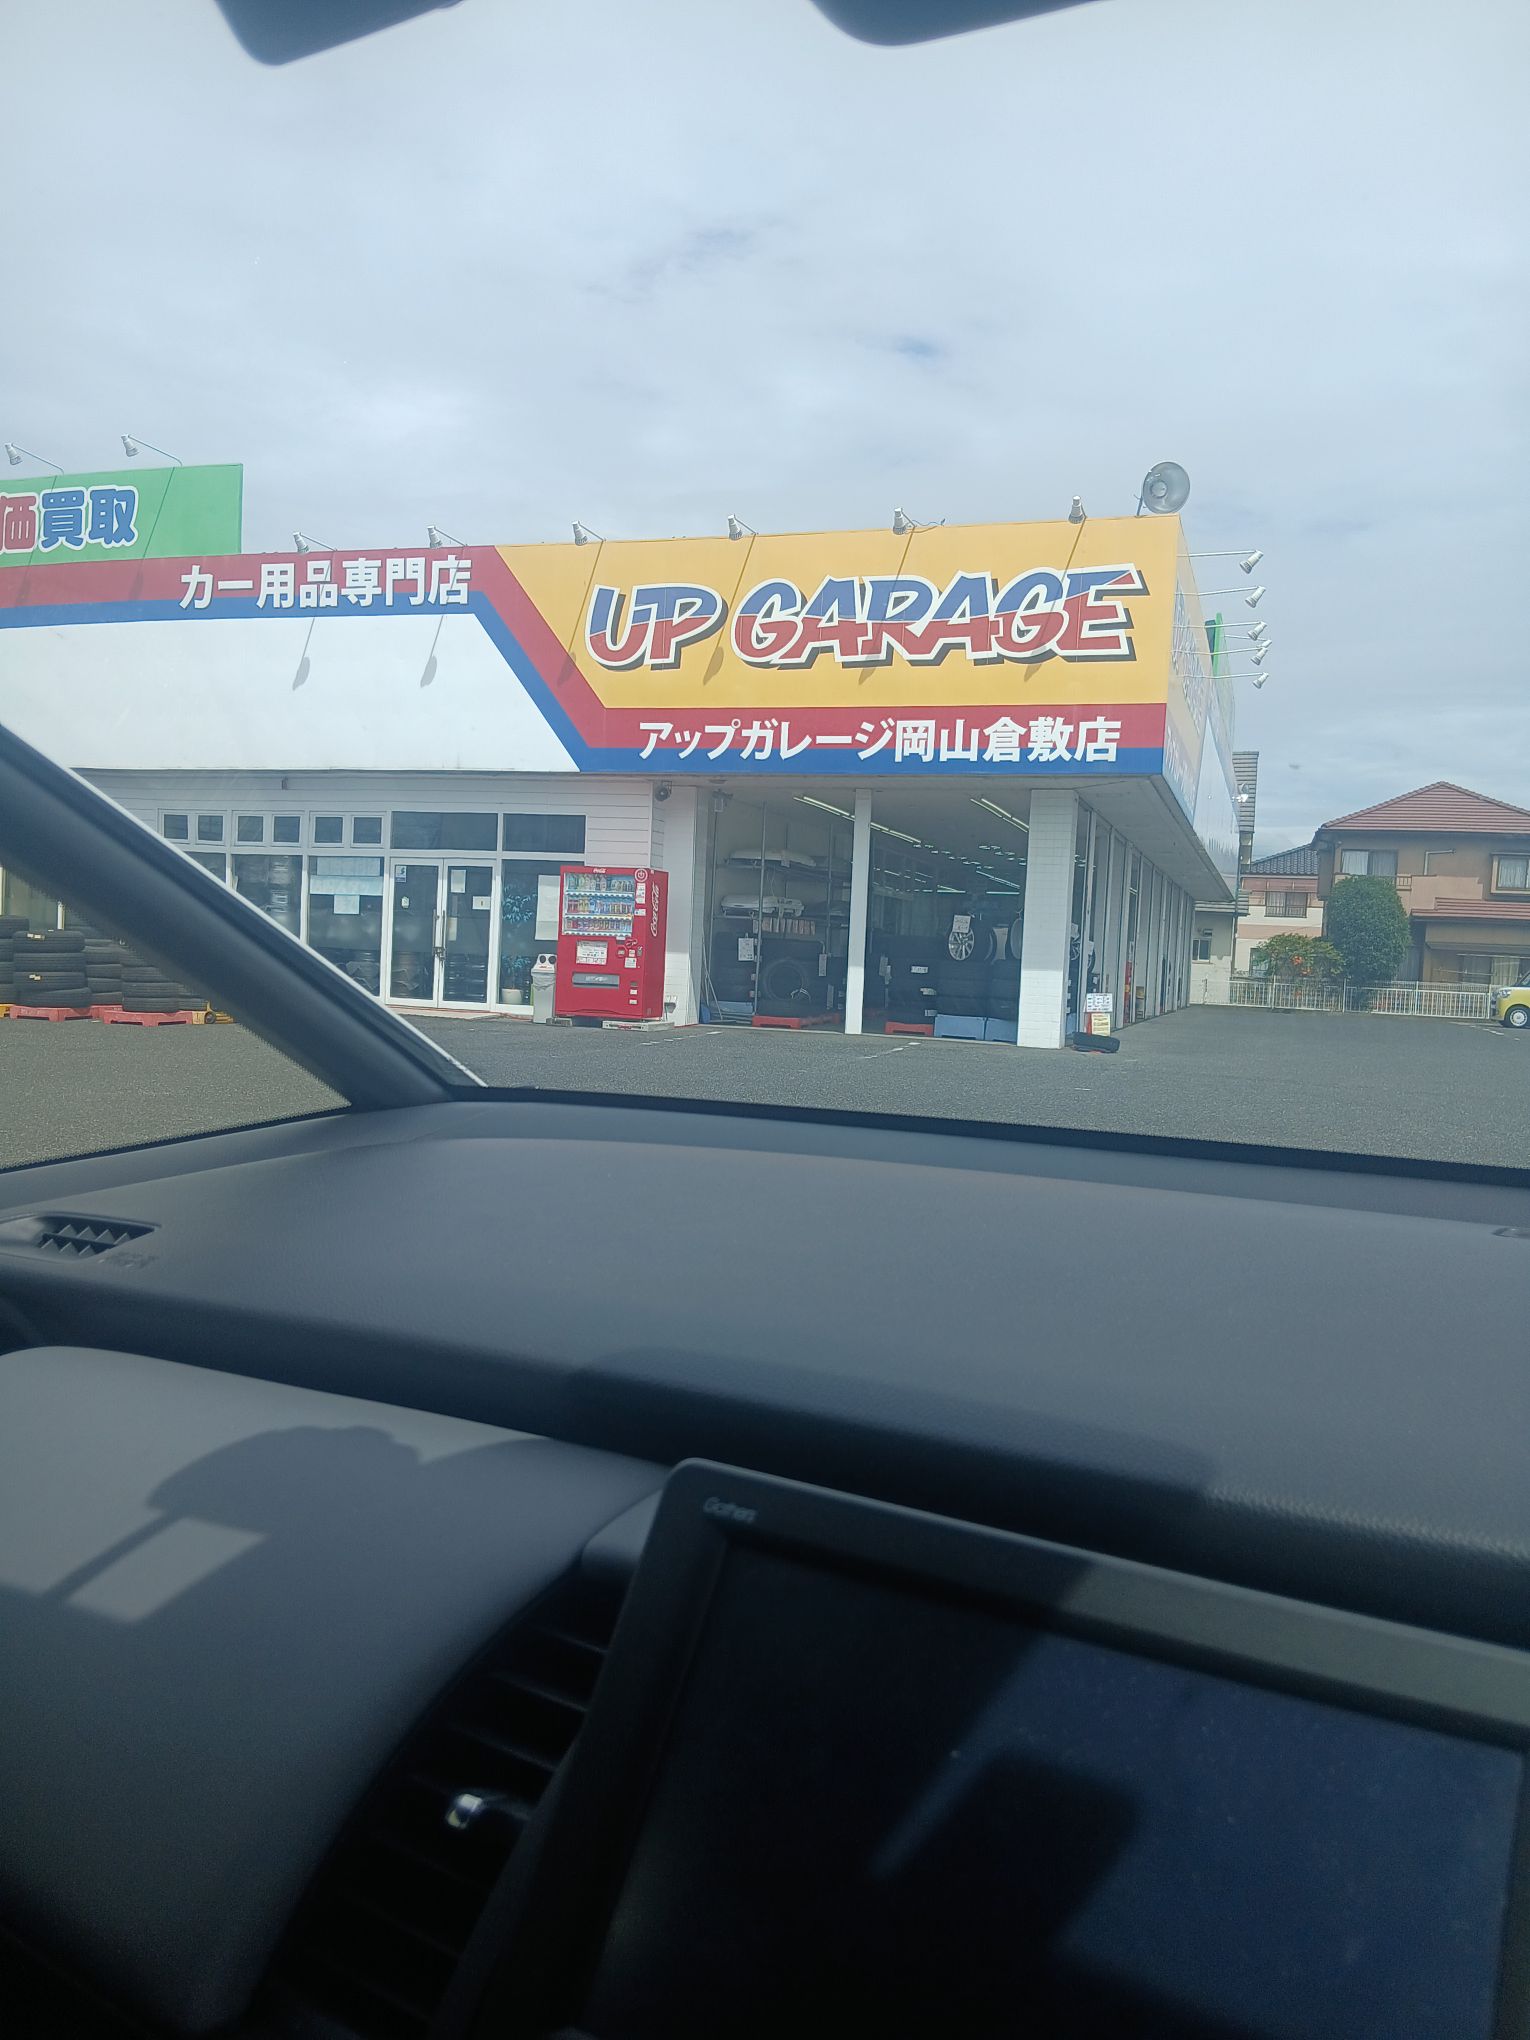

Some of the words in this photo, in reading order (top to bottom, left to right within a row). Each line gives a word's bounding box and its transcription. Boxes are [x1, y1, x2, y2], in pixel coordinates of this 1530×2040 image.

[0, 486, 138, 553] 価買取
[179, 555, 472, 609] カー用品専門店
[586, 583, 728, 669] UP
[731, 563, 1148, 669] GARAGE
[640, 717, 1121, 762] アップガレージ岡山倉敷店
